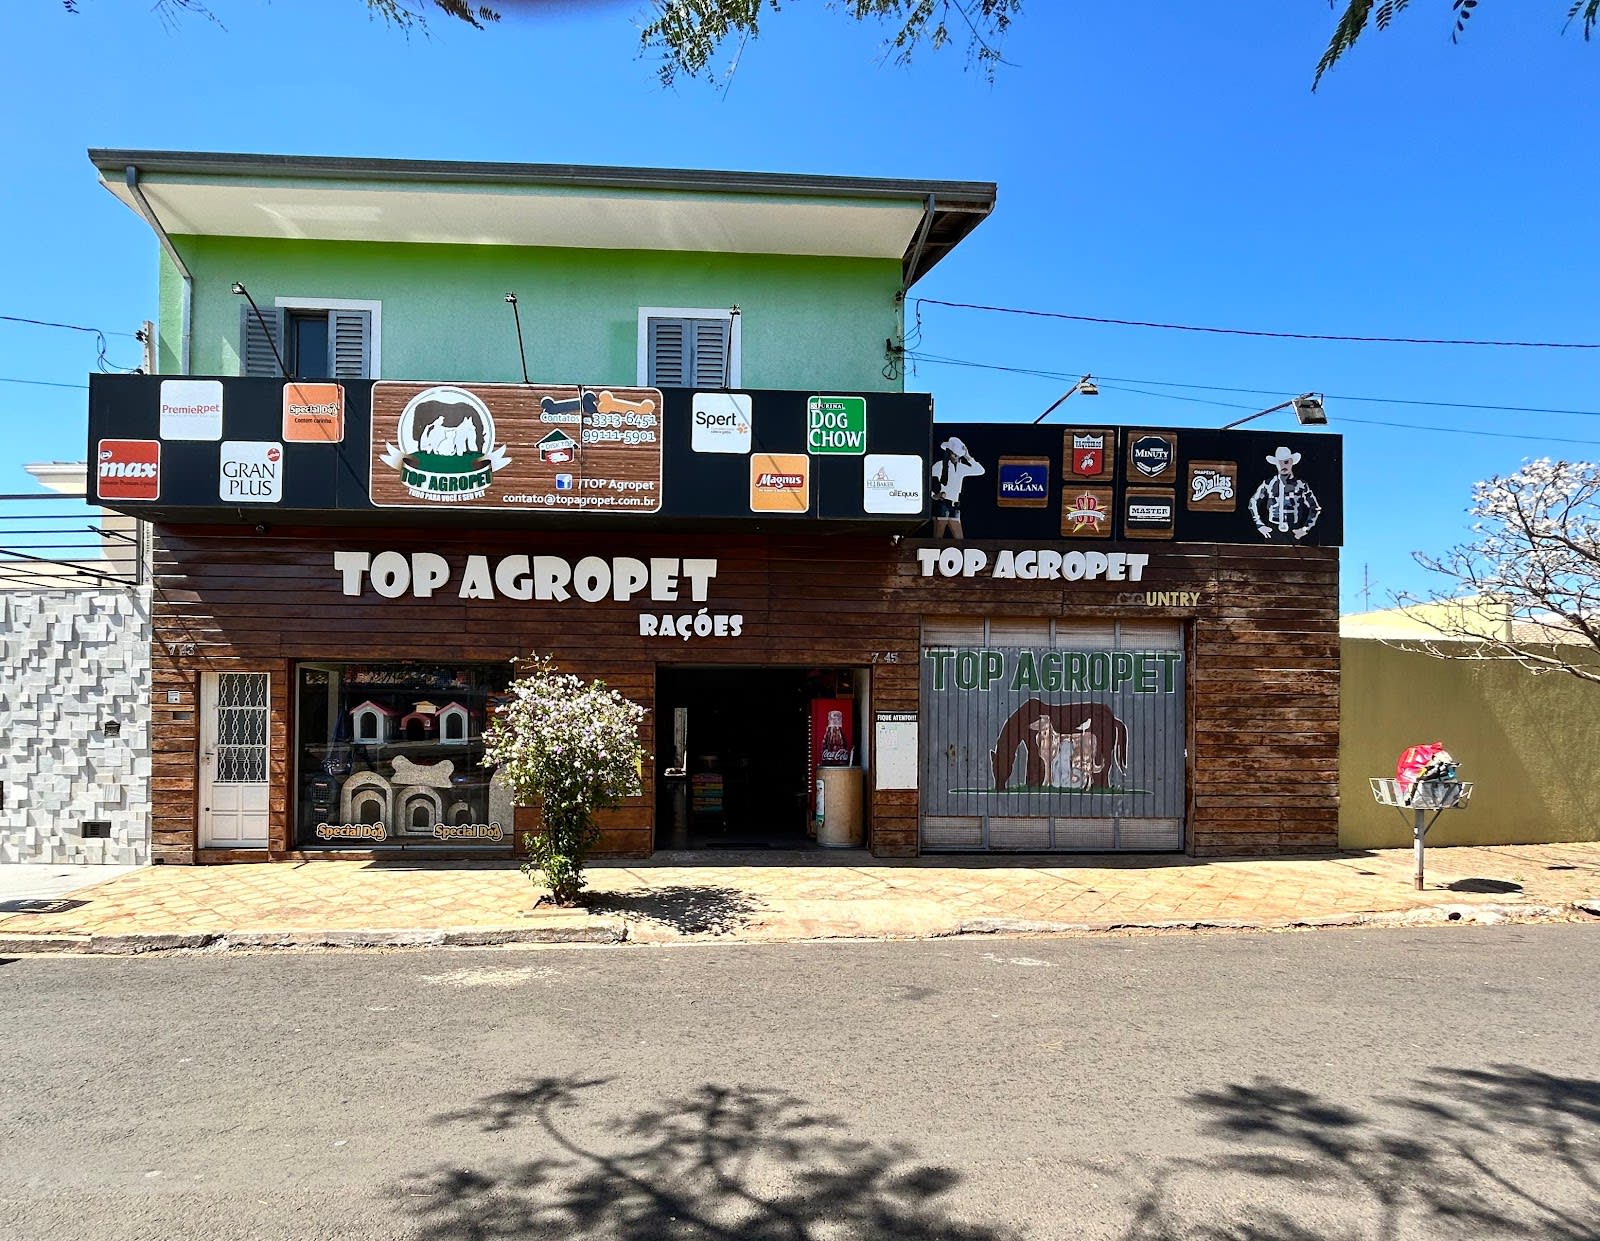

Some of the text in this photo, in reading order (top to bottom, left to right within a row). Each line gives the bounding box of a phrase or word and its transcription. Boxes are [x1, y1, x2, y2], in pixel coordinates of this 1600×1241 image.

[290, 404, 320, 416] Special
[541, 413, 580, 423] Contatos
[593, 412, 656, 427] 3313-6451
[696, 411, 736, 428] Spert
[811, 410, 848, 429] DOG
[583, 430, 655, 442] 99111-5901
[810, 429, 861, 447] CHOW
[1135, 448, 1169, 458] MINUTY
[100, 461, 158, 478] max
[222, 461, 275, 479] GRAN
[230, 480, 272, 496] PLUS
[402, 467, 493, 492] TOP AGROPET
[608, 479, 655, 492] Agropet
[756, 474, 802, 489] Magnus
[1002, 483, 1045, 492] PRALANA
[1192, 474, 1233, 501] Dallas
[408, 488, 424, 499] TUDO
[425, 491, 441, 501] PARA
[463, 492, 475, 500] SEU
[475, 489, 486, 498] PET
[503, 494, 656, 506] contato@topagropet.com.br
[917, 547, 1150, 582] TOP AGROPET
[333, 550, 718, 603] TOP AGROPET
[639, 607, 744, 641] RAÇÕES
[925, 650, 1182, 694] TOP AGROPET
[317, 822, 387, 842] Special Dog
[433, 822, 503, 842] Special Dog
